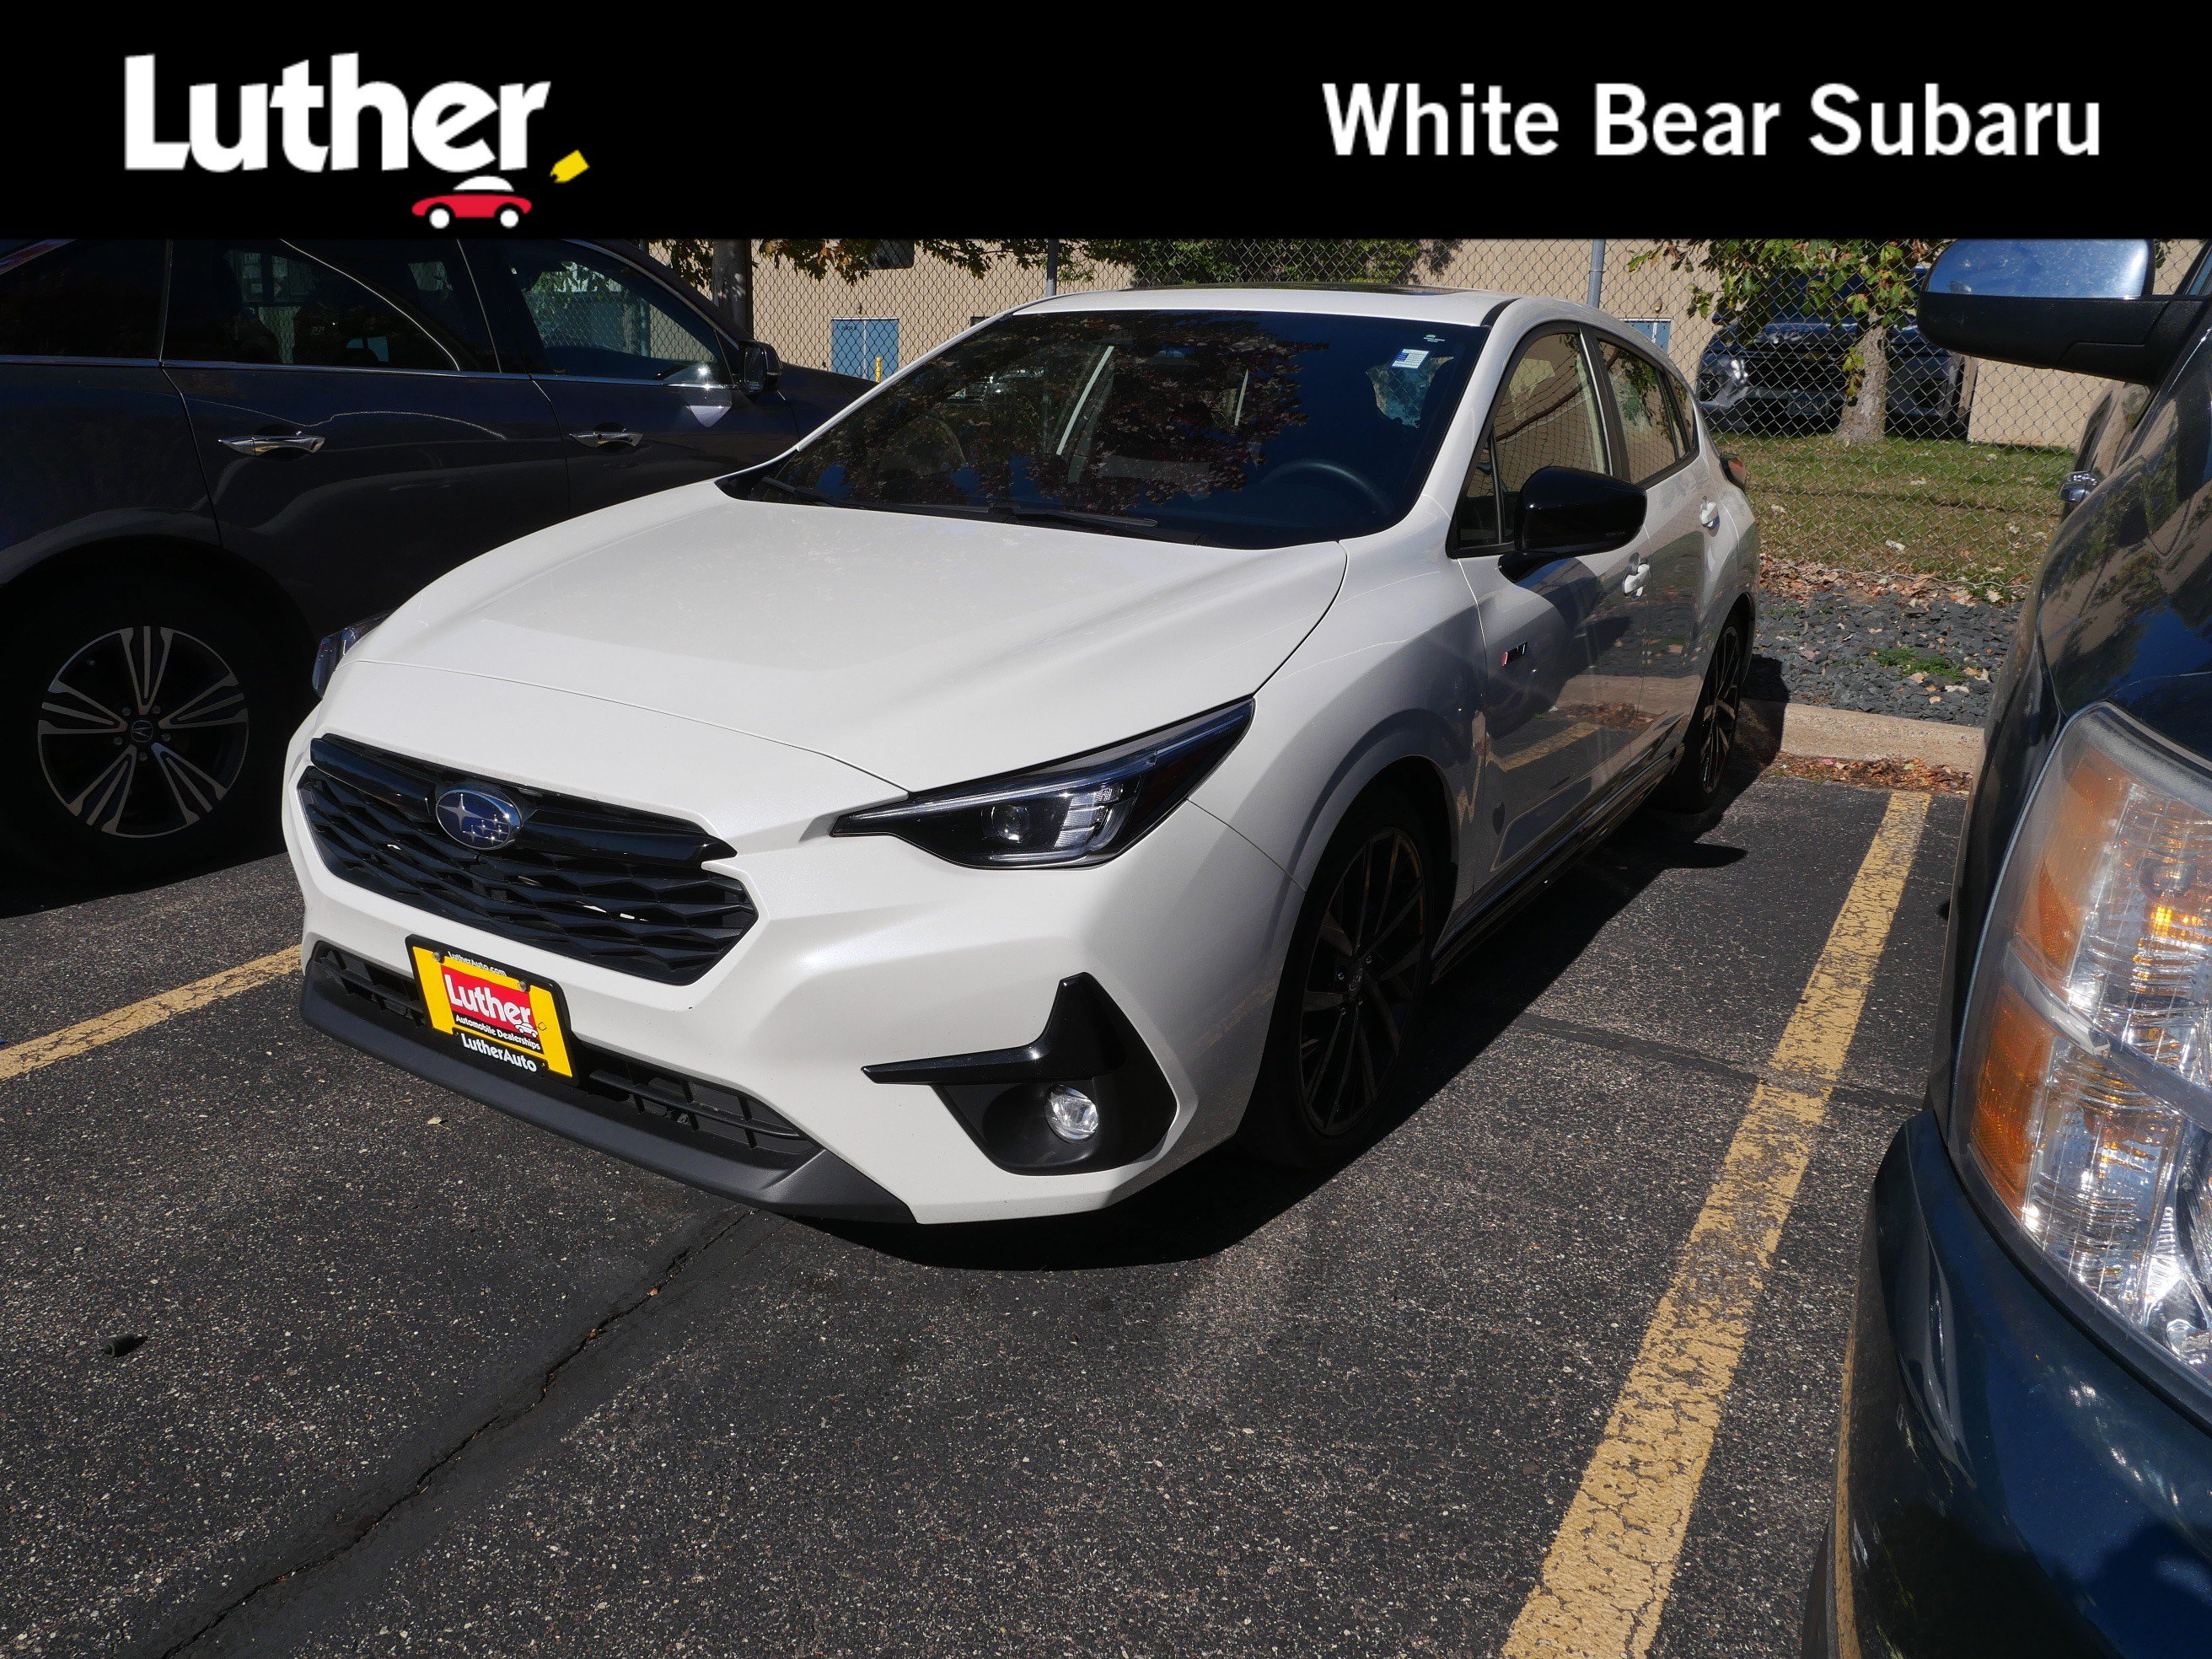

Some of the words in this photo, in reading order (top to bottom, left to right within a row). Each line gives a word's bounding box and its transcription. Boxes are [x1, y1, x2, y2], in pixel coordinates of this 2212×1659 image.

[448, 951, 507, 976] LutherAuto.com
[443, 974, 531, 1023] Luther
[455, 1015, 497, 1036] Automobile
[497, 1028, 541, 1051] Dealerships
[461, 1033, 537, 1072] LutherAuto
